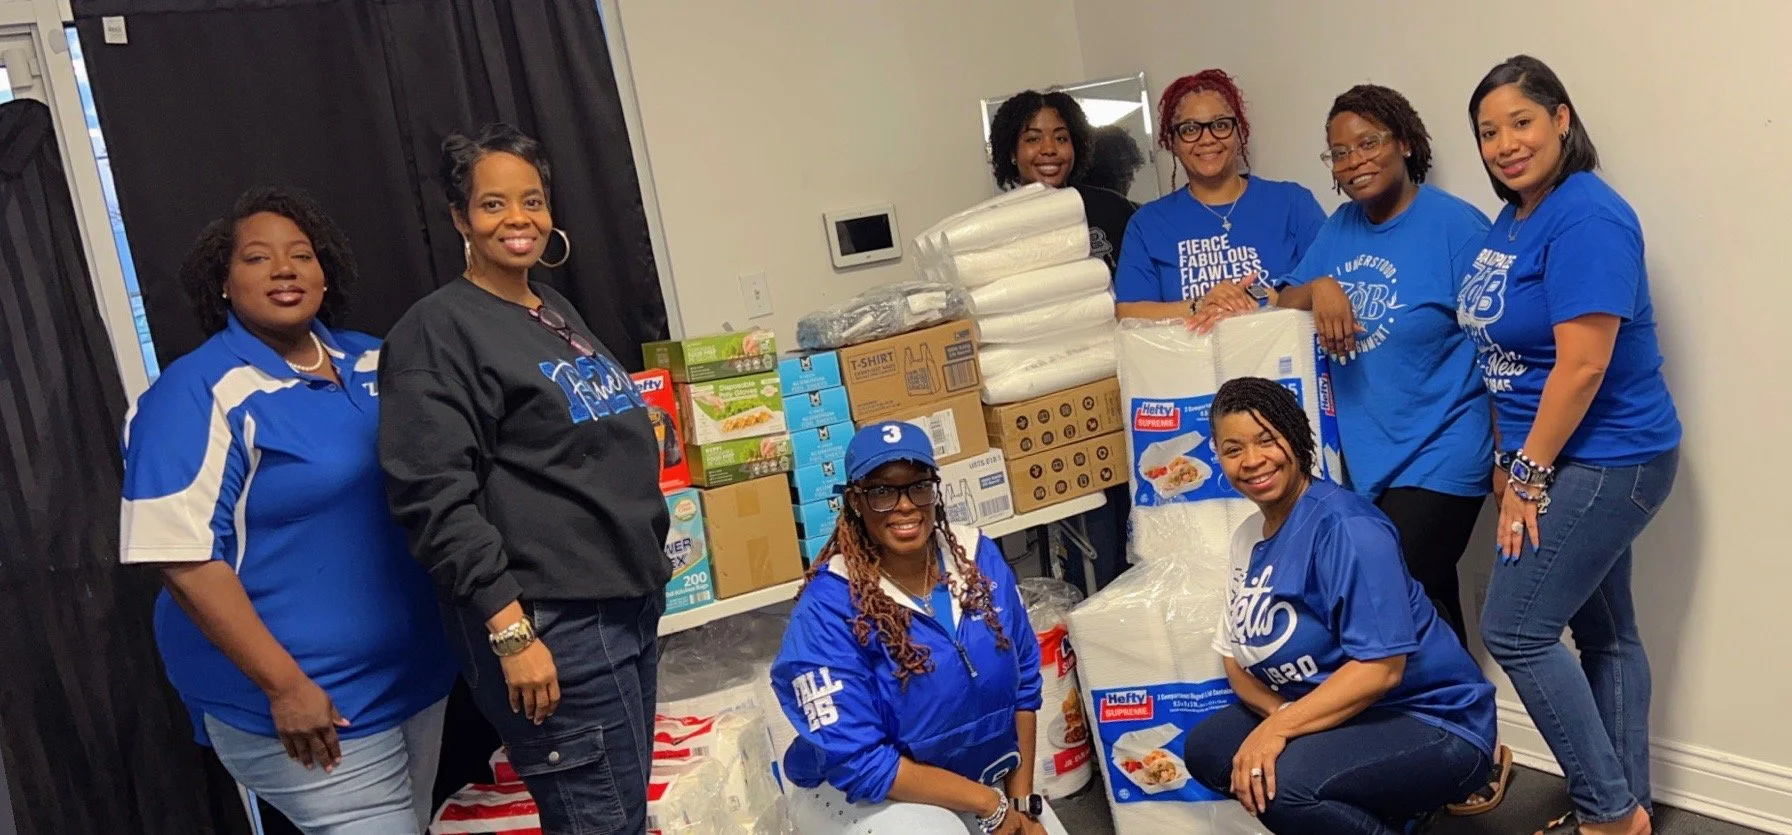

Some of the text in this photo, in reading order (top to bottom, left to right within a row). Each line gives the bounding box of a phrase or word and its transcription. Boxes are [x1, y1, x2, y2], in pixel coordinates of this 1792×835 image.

[1178, 233, 1231, 256] FIERCE
[1179, 246, 1259, 268] FABULOUS
[1180, 259, 1262, 286] FLAWLESS
[850, 352, 893, 370] T-SHIRT
[638, 379, 662, 391] efty
[1143, 404, 1173, 416] Hefty
[1138, 418, 1174, 427] SUPREME
[882, 425, 901, 443] 3
[666, 538, 692, 554] WER
[672, 555, 686, 569] EX
[683, 571, 707, 587] 200
[792, 667, 844, 708] FALL
[1108, 693, 1145, 704] Hefty
[803, 694, 839, 732] 25
[1105, 708, 1149, 717] SUPREME
